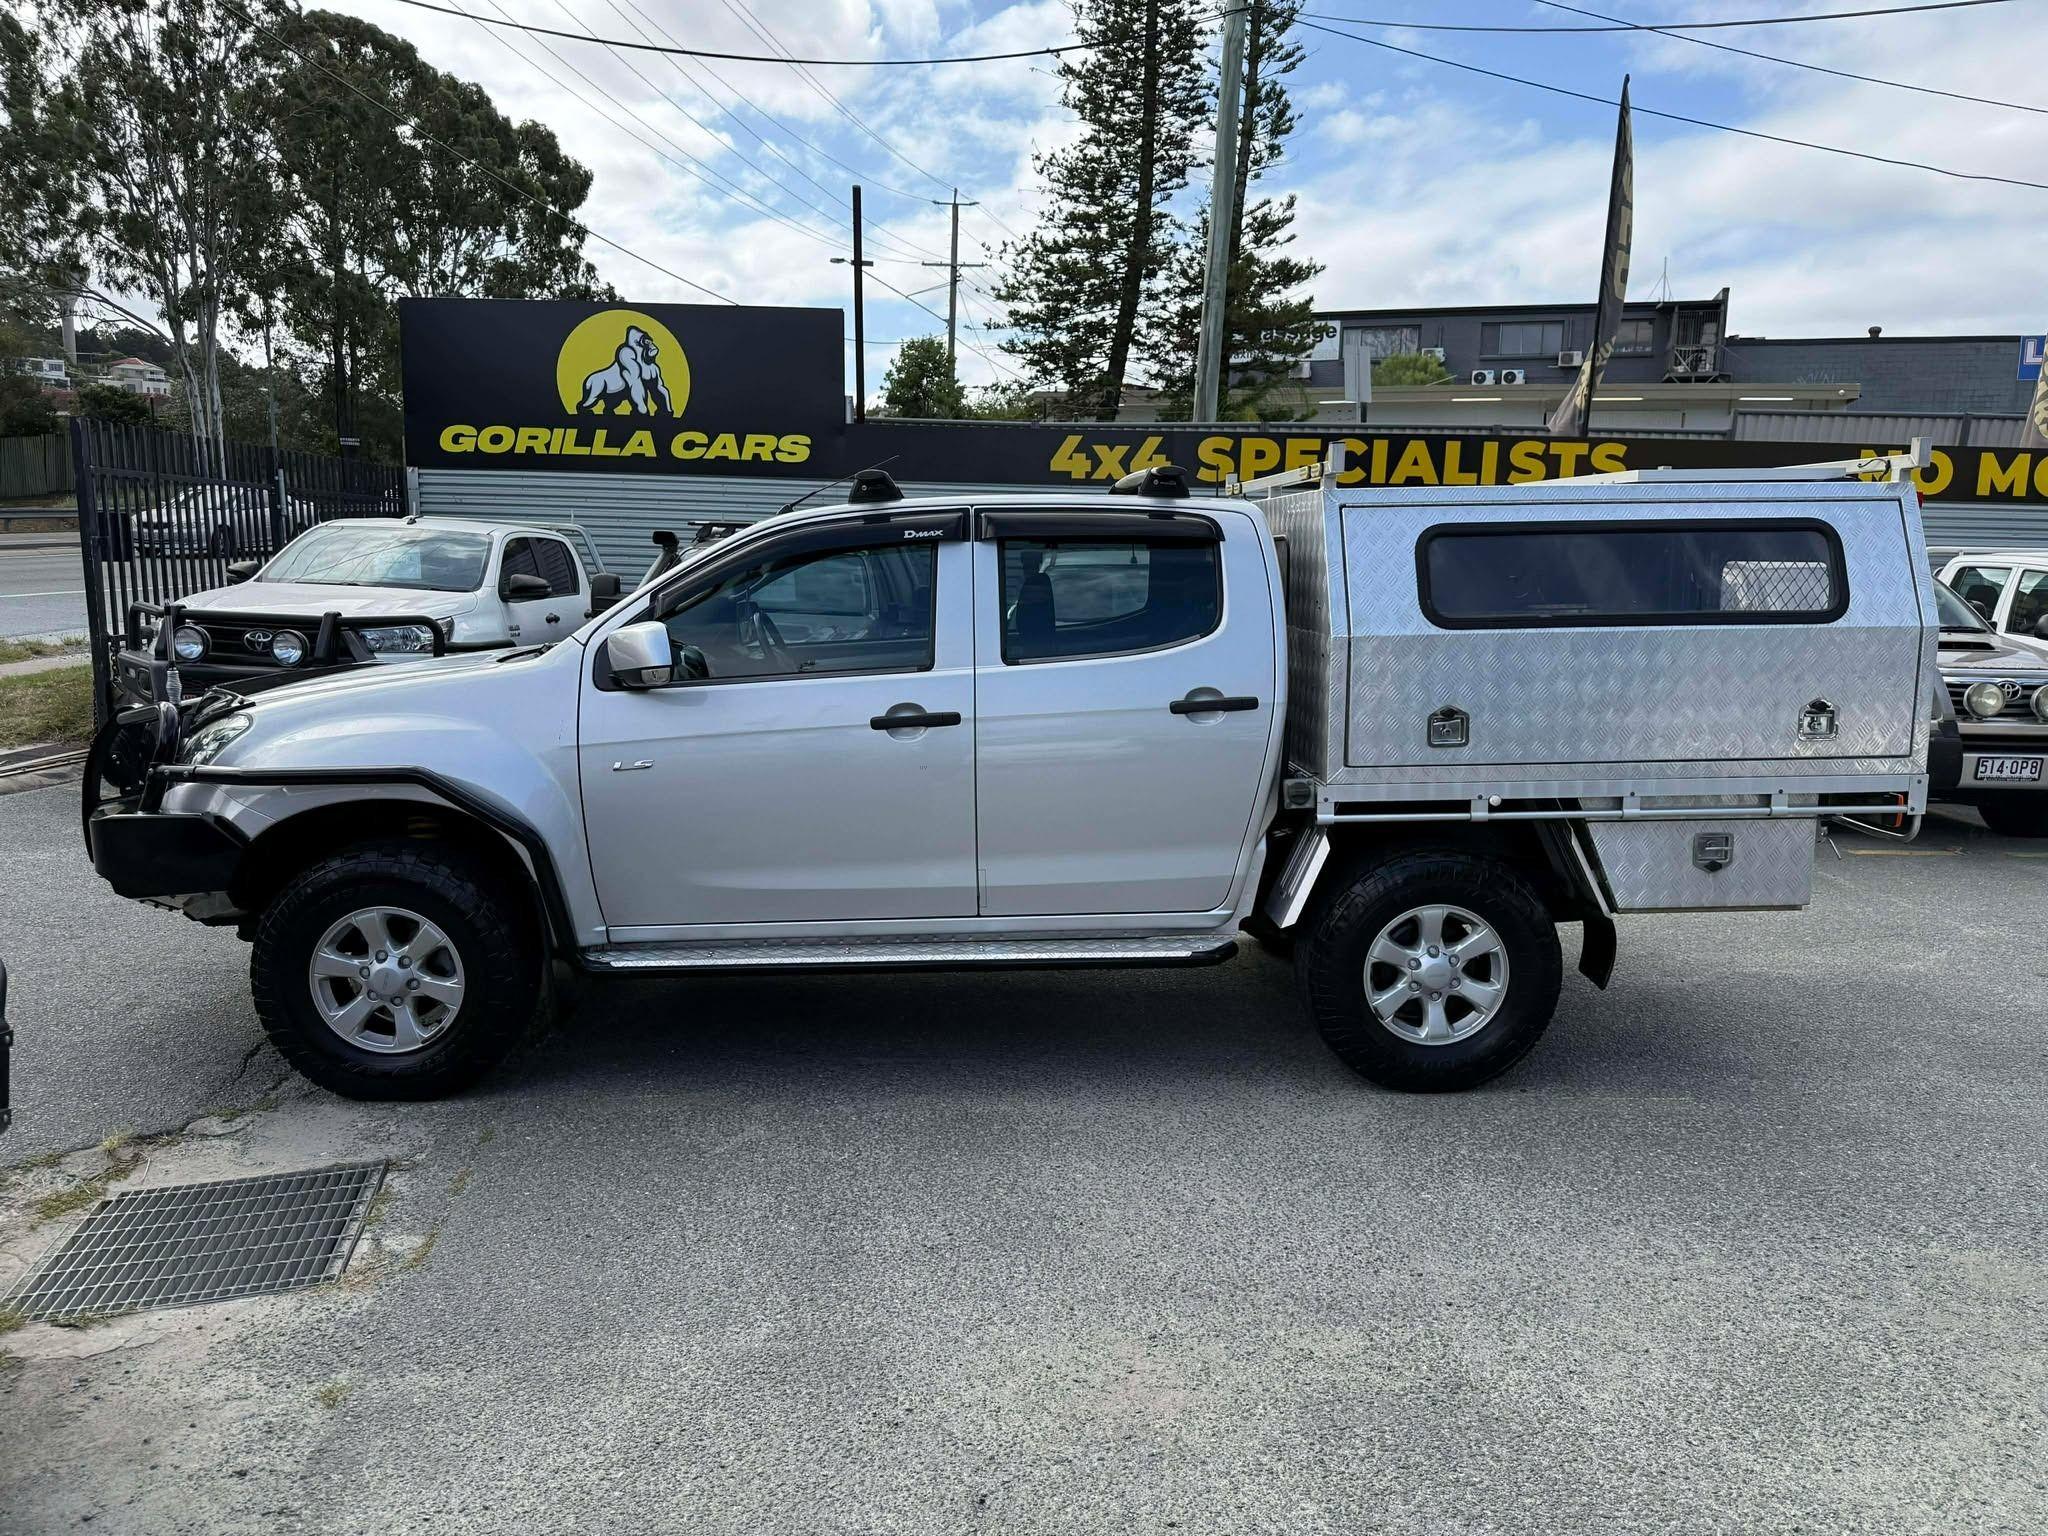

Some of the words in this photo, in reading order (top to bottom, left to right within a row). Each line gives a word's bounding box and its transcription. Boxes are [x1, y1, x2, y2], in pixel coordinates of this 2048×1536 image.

[439, 424, 658, 458] GORILLA
[670, 431, 813, 463] CARS
[1050, 434, 1172, 480] 4x4
[1196, 436, 1629, 485] SPECIALISTS
